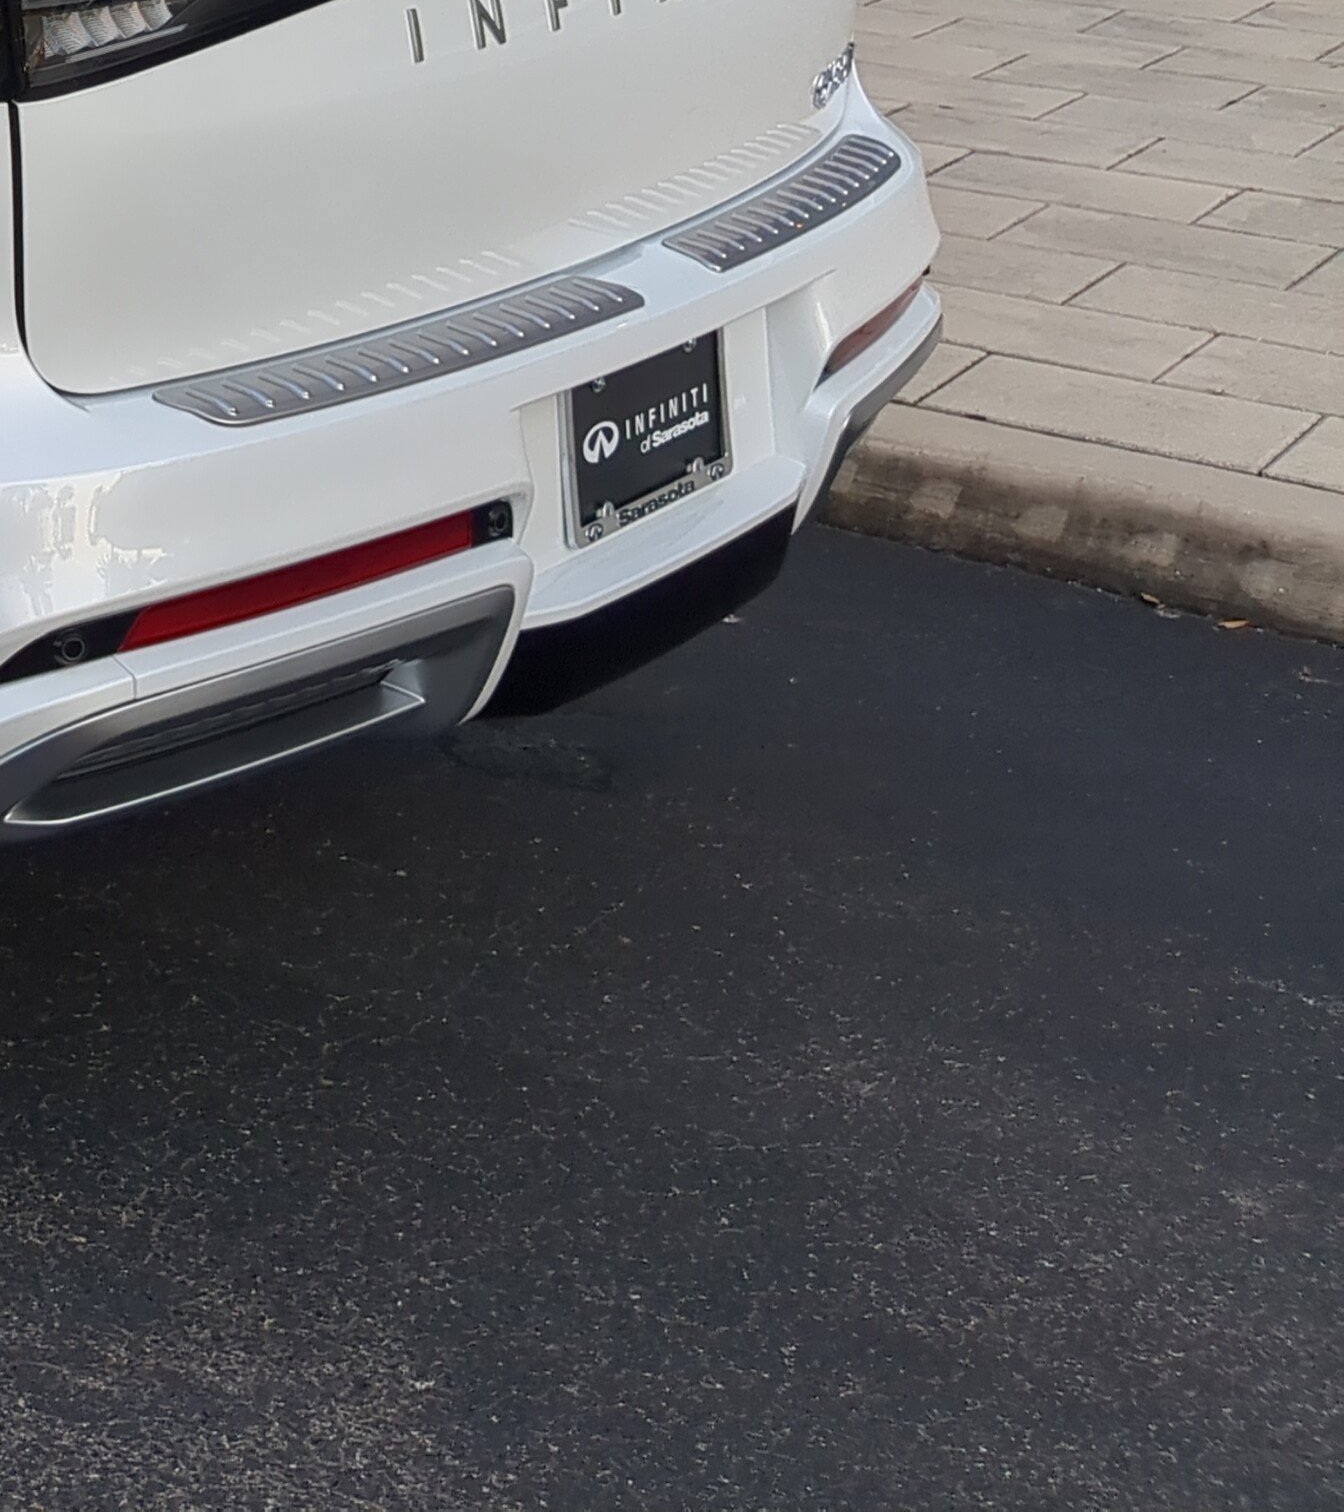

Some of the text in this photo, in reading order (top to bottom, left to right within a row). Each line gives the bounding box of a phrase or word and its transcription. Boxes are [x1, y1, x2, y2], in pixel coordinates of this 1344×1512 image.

[625, 382, 708, 440] INFINITI
[640, 411, 710, 454] of Sarasota
[618, 480, 696, 527] Sarasota
